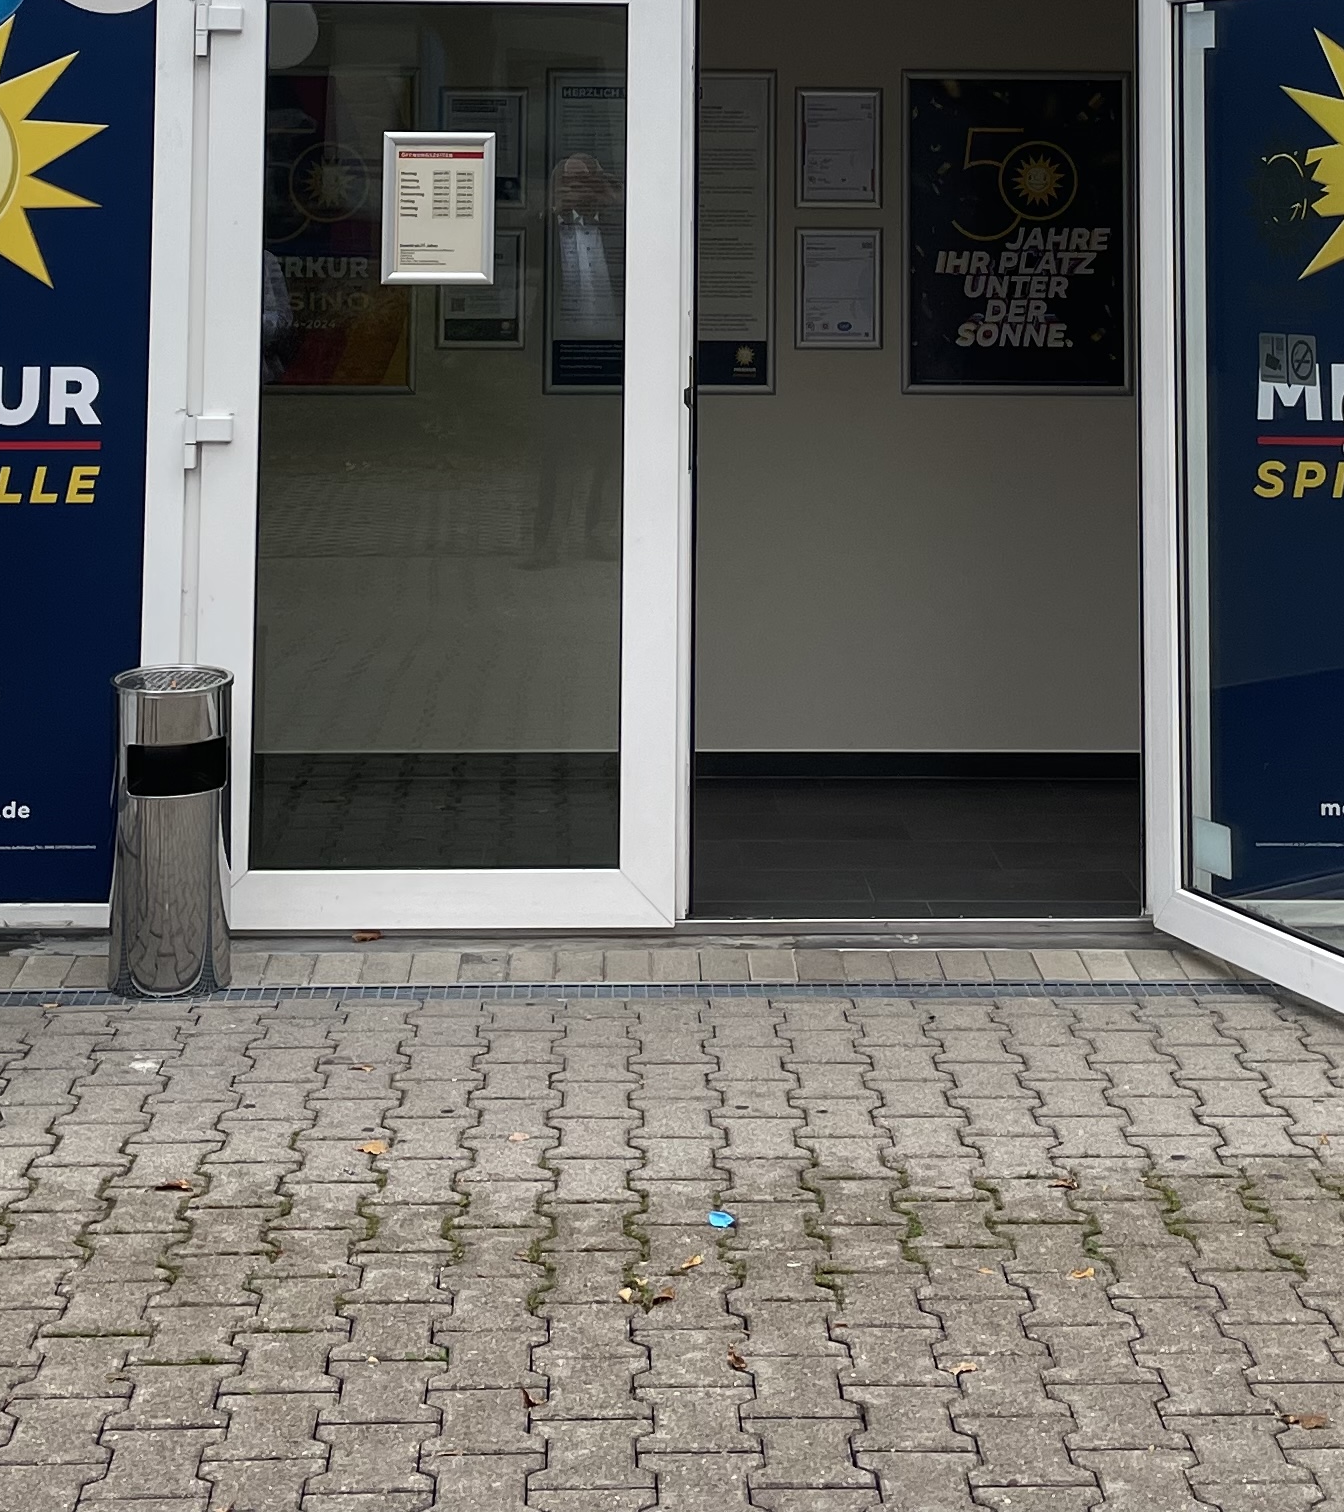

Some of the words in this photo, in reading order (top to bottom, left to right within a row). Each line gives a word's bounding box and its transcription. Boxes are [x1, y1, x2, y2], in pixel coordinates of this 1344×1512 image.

[563, 87, 620, 98] HERZLICH
[951, 127, 1079, 242] 50
[1005, 227, 1112, 251] JAHRE
[934, 251, 991, 275] IHR
[998, 251, 1098, 275] PLATZ
[963, 275, 1070, 299] UNTER
[288, 291, 370, 312] SINO
[984, 299, 1048, 323] DER
[955, 322, 1074, 348] SONNE.
